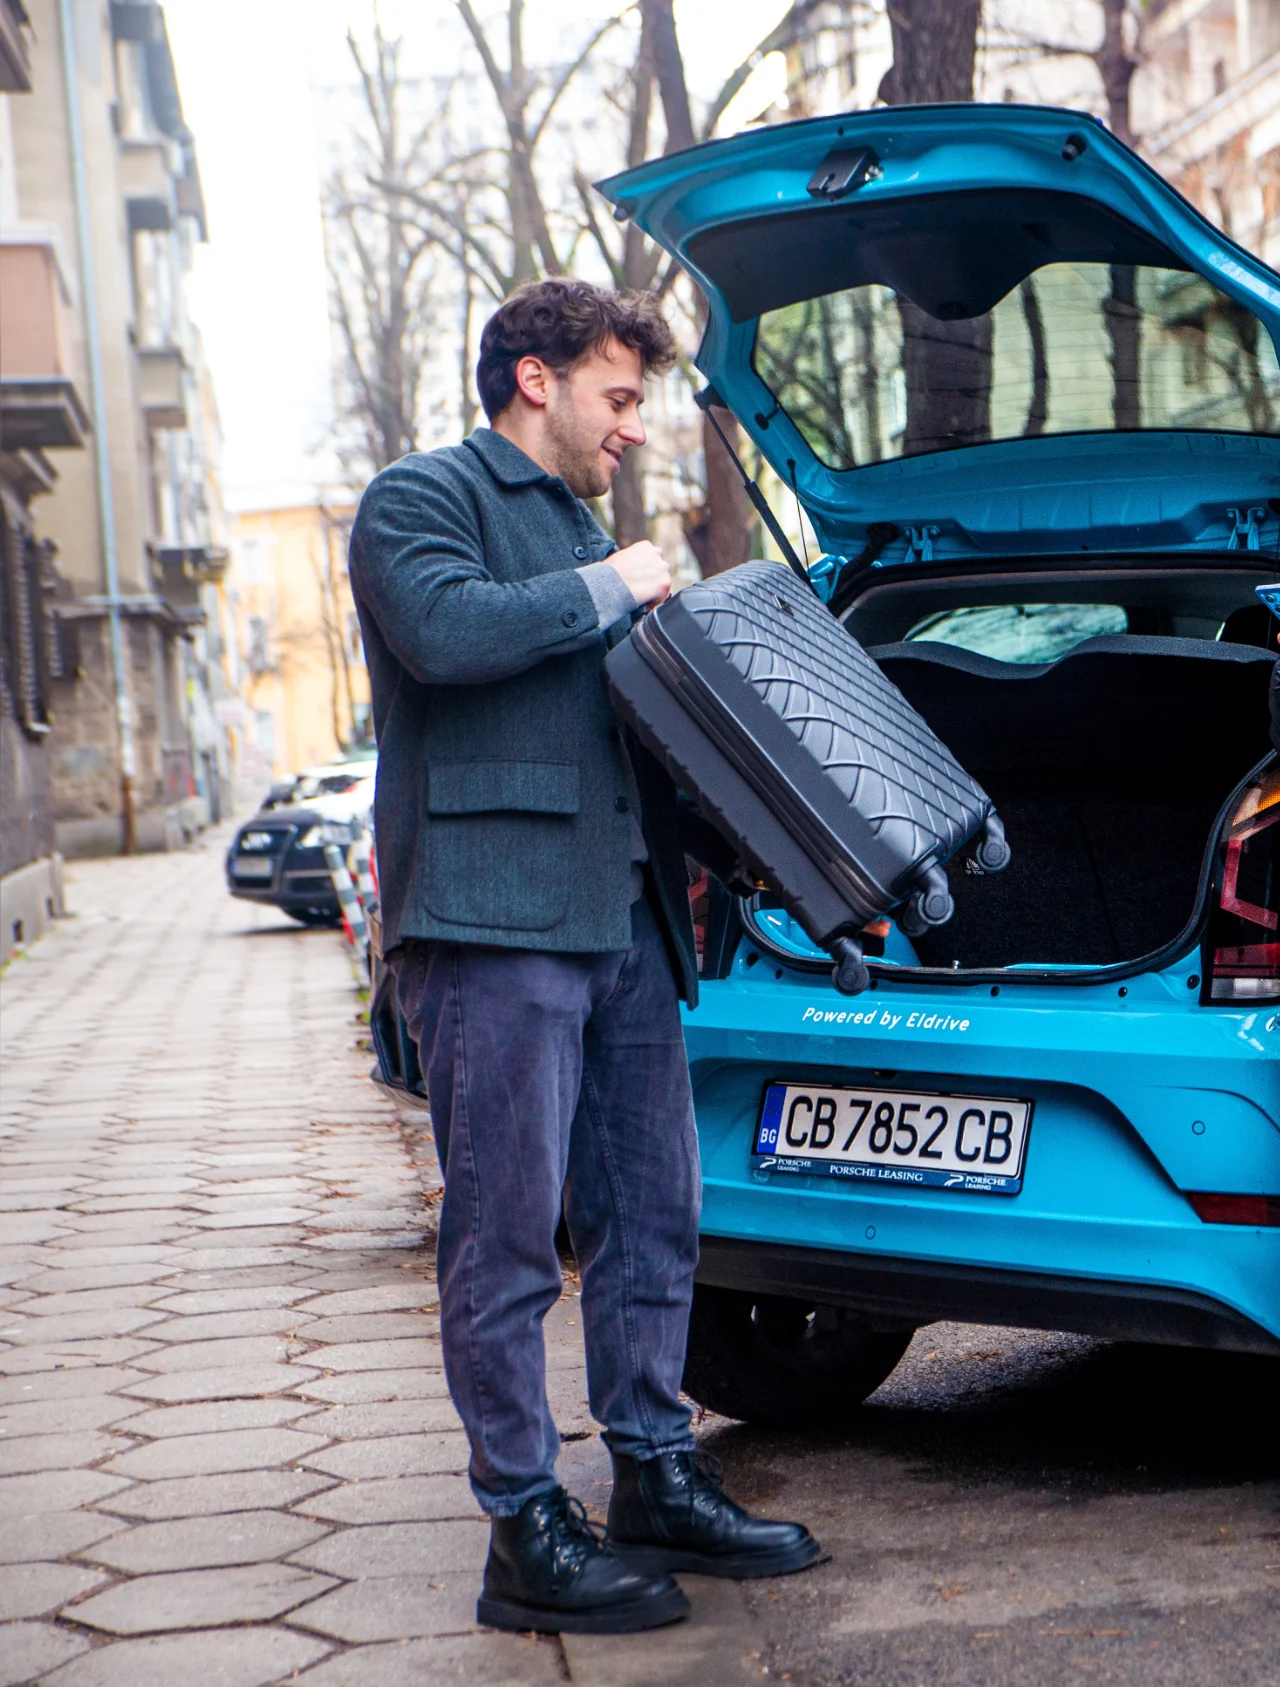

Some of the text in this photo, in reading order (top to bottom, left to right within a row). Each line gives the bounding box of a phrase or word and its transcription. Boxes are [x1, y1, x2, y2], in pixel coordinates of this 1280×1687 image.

[802, 1007, 970, 1032] Powered by Eldrive
[760, 1127, 777, 1145] BG
[785, 1095, 1014, 1165] CB 7852 CB
[778, 1158, 812, 1168] PORSCHE
[829, 1164, 924, 1182] PORSCHE LEASING
[965, 1175, 1007, 1187] PORSCHE
